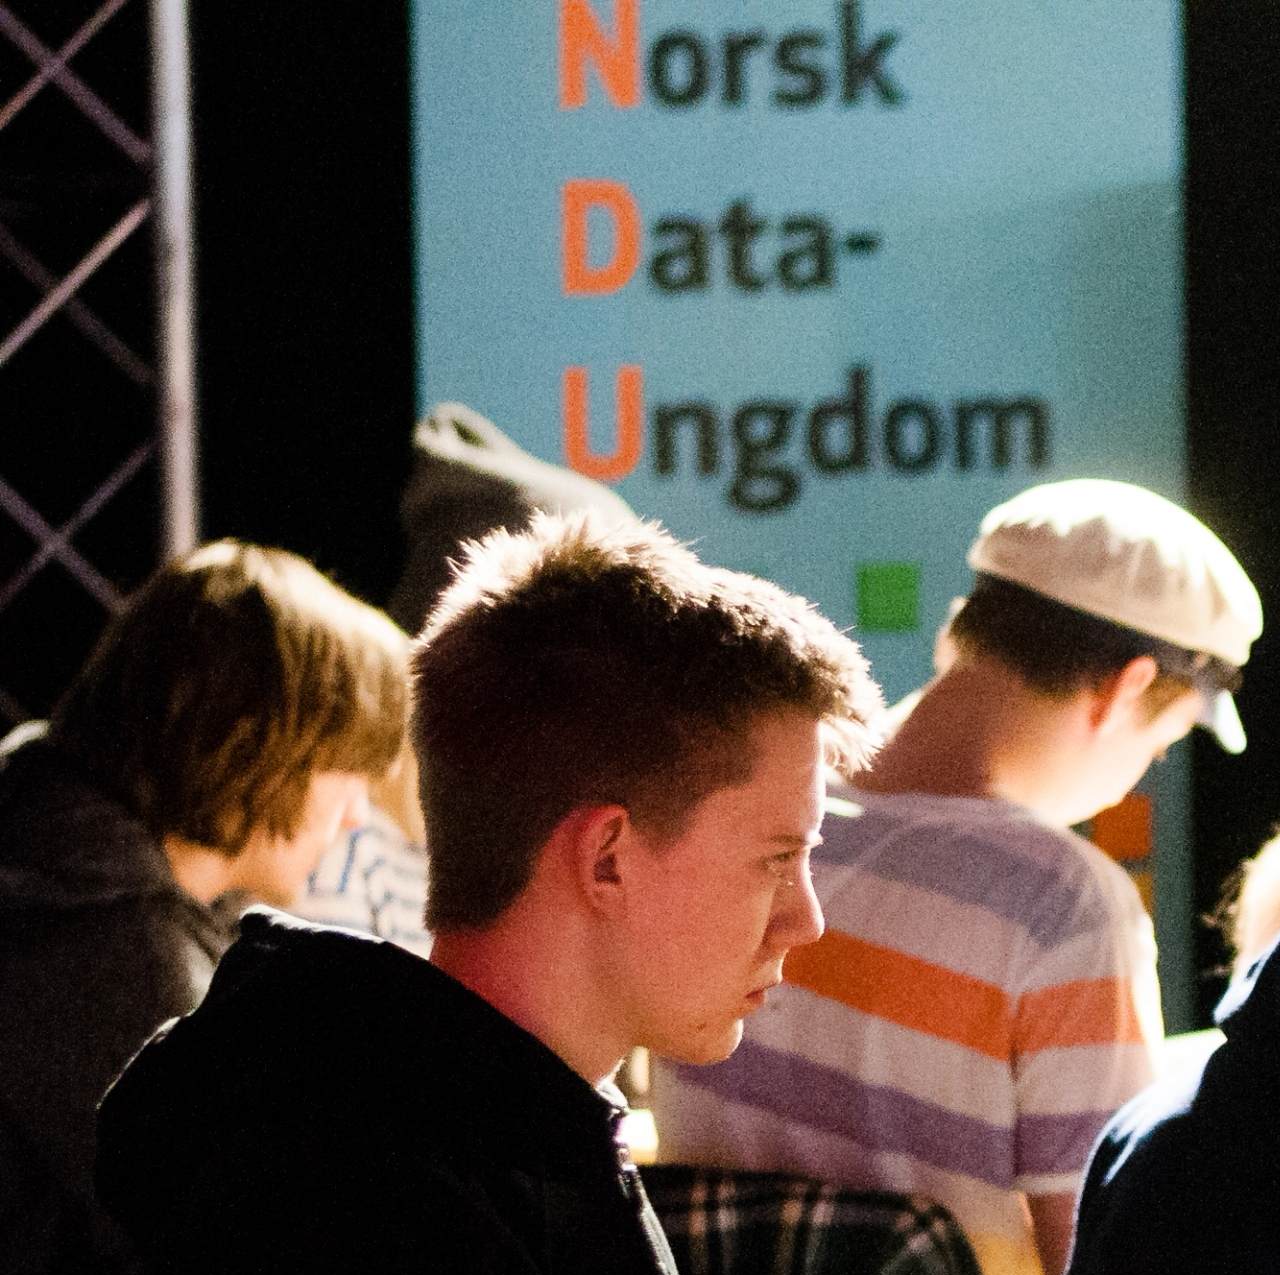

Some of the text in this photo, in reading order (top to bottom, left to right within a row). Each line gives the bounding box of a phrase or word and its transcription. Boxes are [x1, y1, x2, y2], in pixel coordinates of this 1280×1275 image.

[558, 0, 905, 110] Norsk
[560, 178, 881, 295] Data-
[562, 365, 1052, 513] Ungdom
